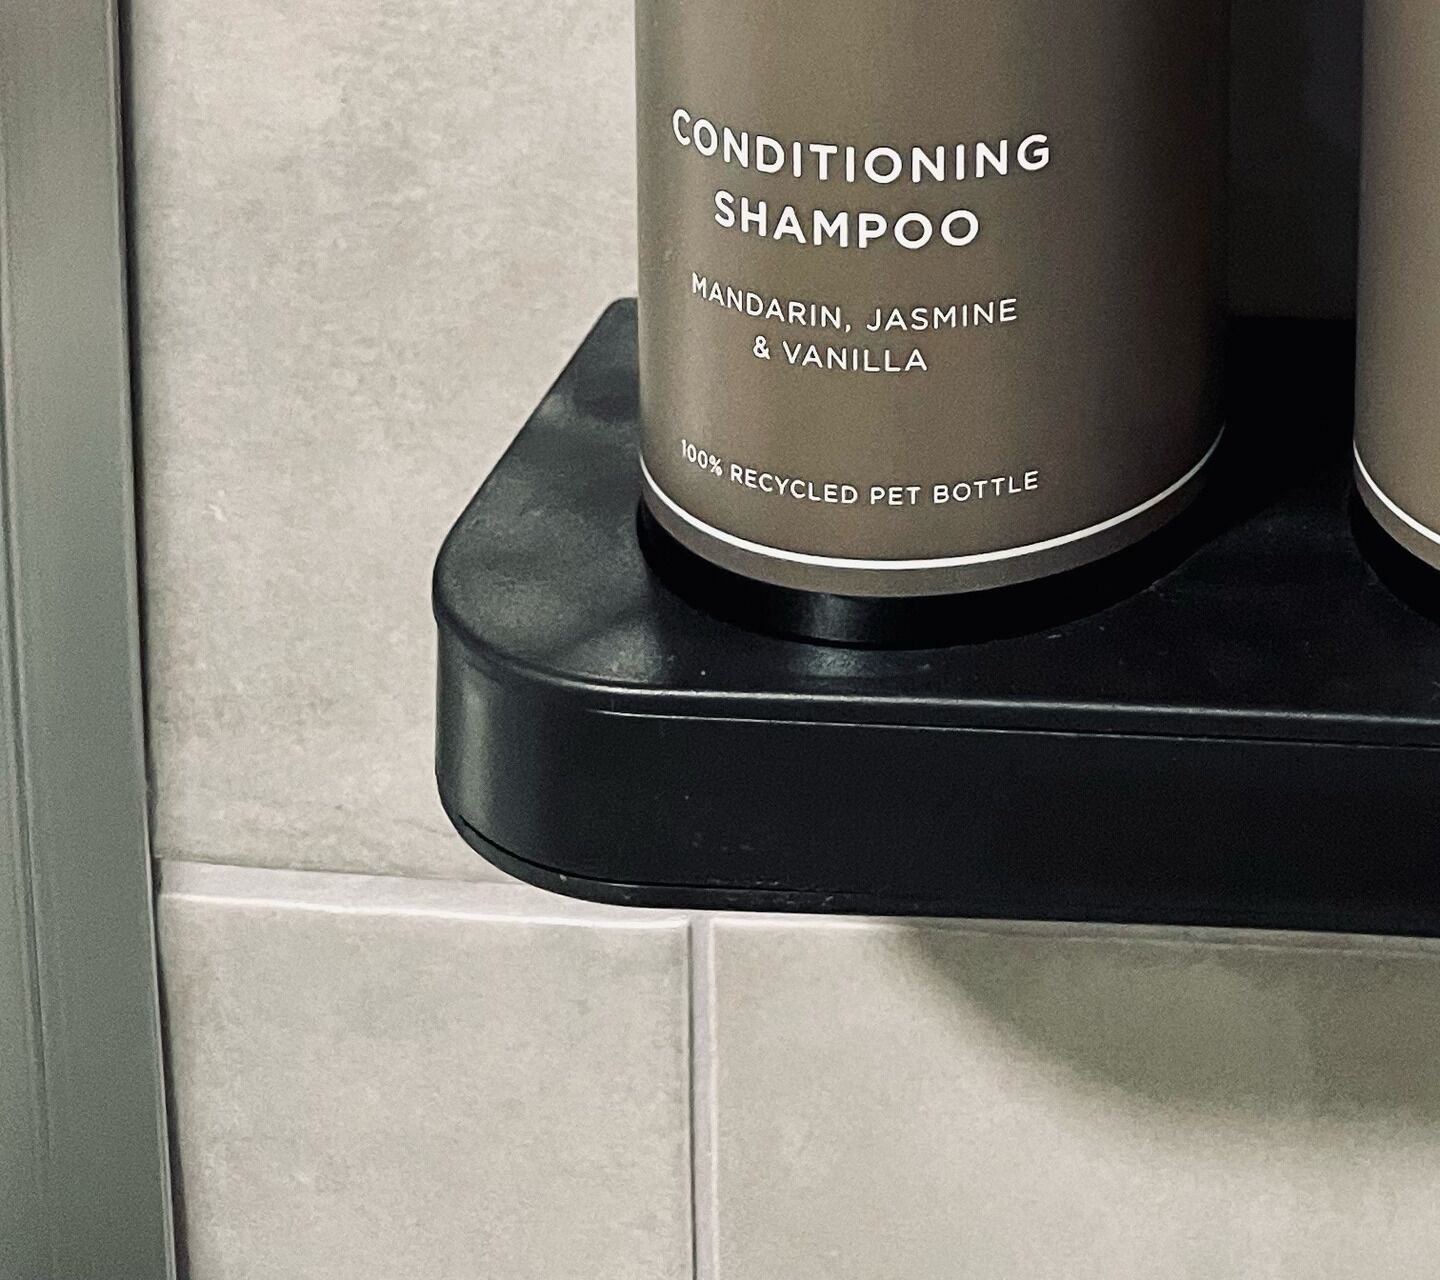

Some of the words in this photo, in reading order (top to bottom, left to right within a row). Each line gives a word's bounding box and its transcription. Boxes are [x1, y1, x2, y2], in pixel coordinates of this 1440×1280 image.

[672, 109, 1050, 185] CONDITIONING
[714, 190, 980, 250] SHAMPOO
[690, 271, 852, 333] MANDARIN,
[866, 298, 1018, 332] JASMINE
[752, 335, 771, 360] &
[782, 340, 929, 373] VANILLA
[681, 438, 723, 477] 100%
[730, 463, 858, 506] RECYCLED
[870, 486, 921, 506] PET
[933, 470, 1039, 504] BOTTLE
